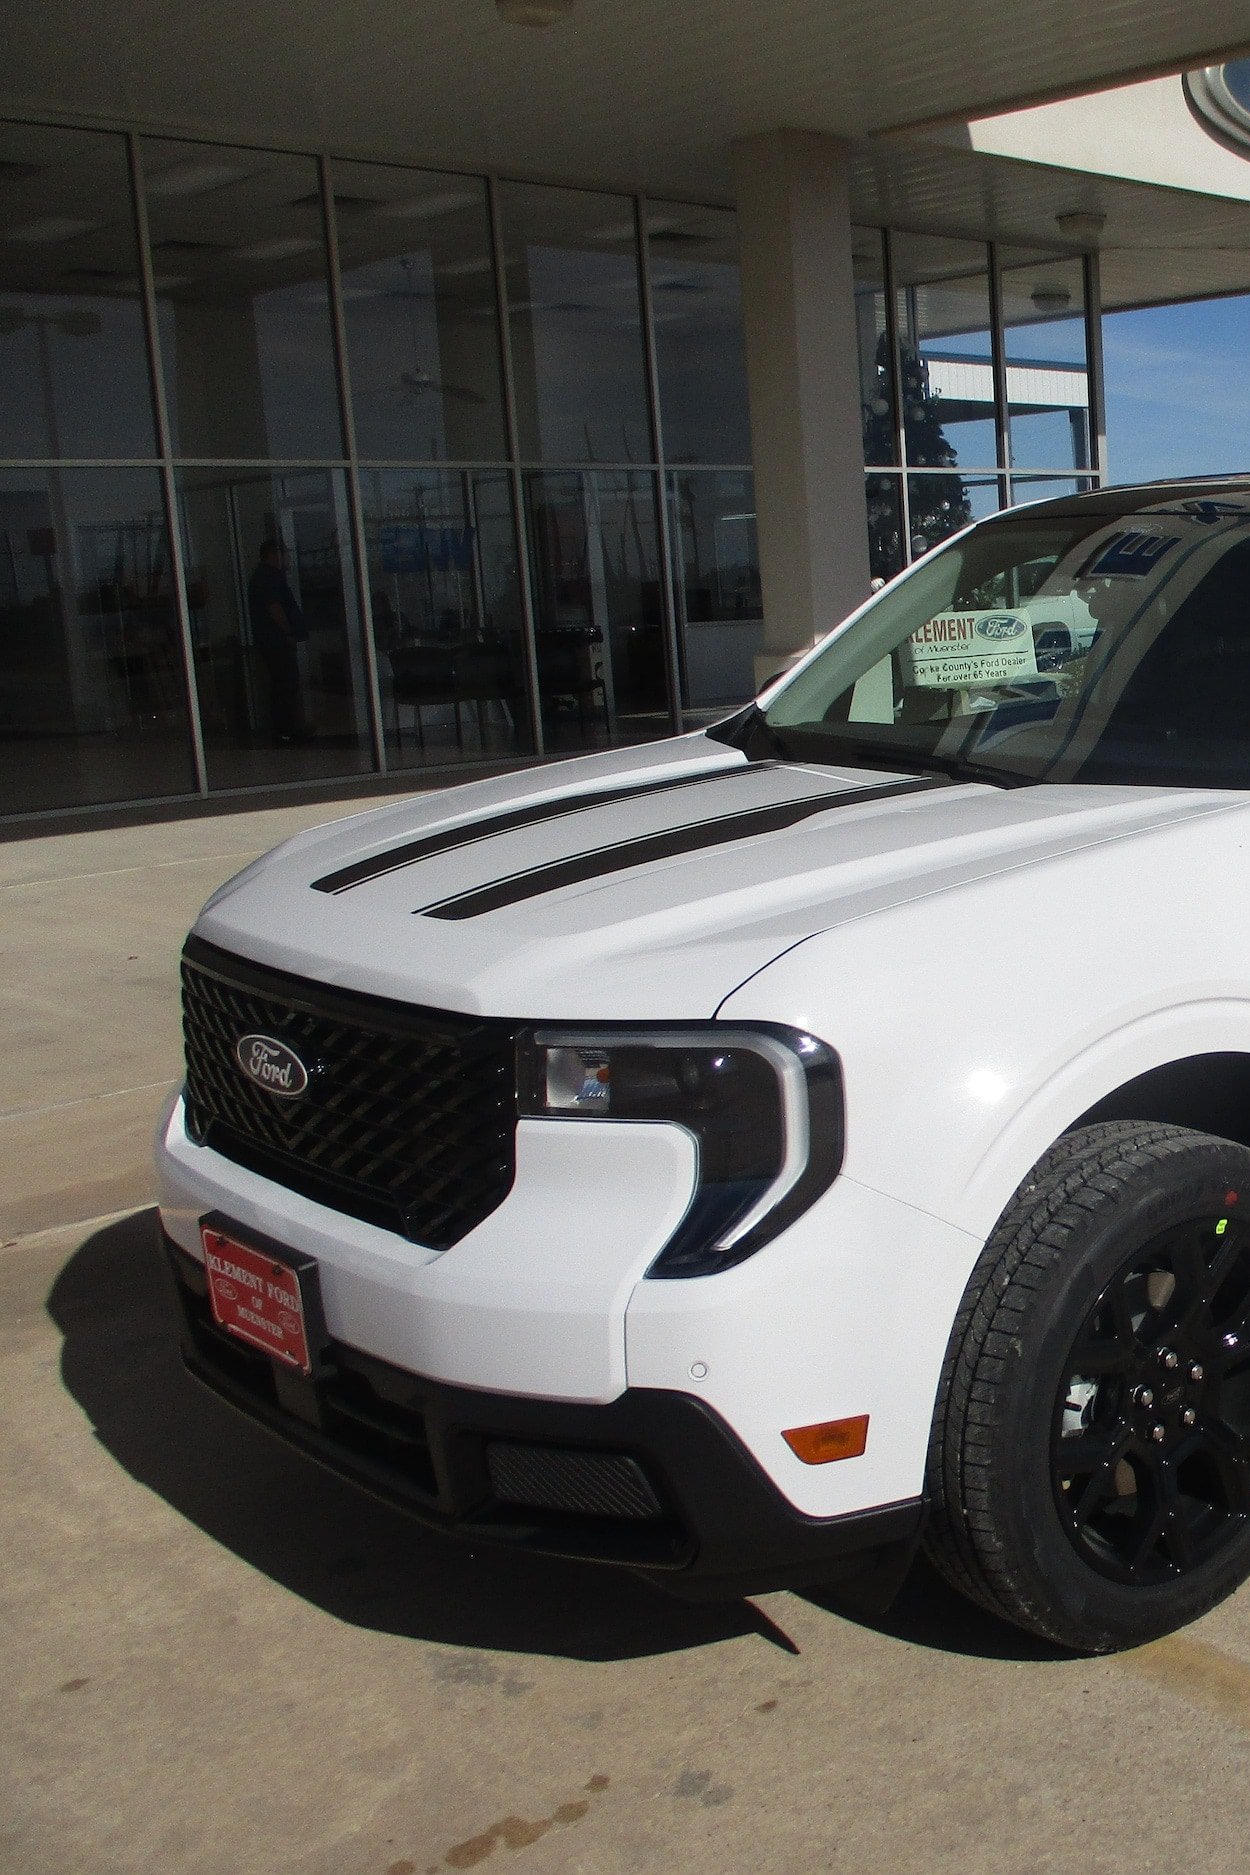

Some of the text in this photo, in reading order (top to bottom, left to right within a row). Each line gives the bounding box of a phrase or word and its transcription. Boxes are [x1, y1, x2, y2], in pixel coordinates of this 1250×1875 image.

[987, 618, 1018, 637] Ford
[942, 660, 979, 672] County's
[980, 658, 1000, 668] Ford
[1001, 656, 1026, 667] Dealer
[953, 672, 971, 681] over
[973, 671, 984, 680] 65
[985, 669, 1008, 679] Years
[250, 1041, 293, 1088] Ford
[206, 1252, 301, 1313] KLEMENT FORD
